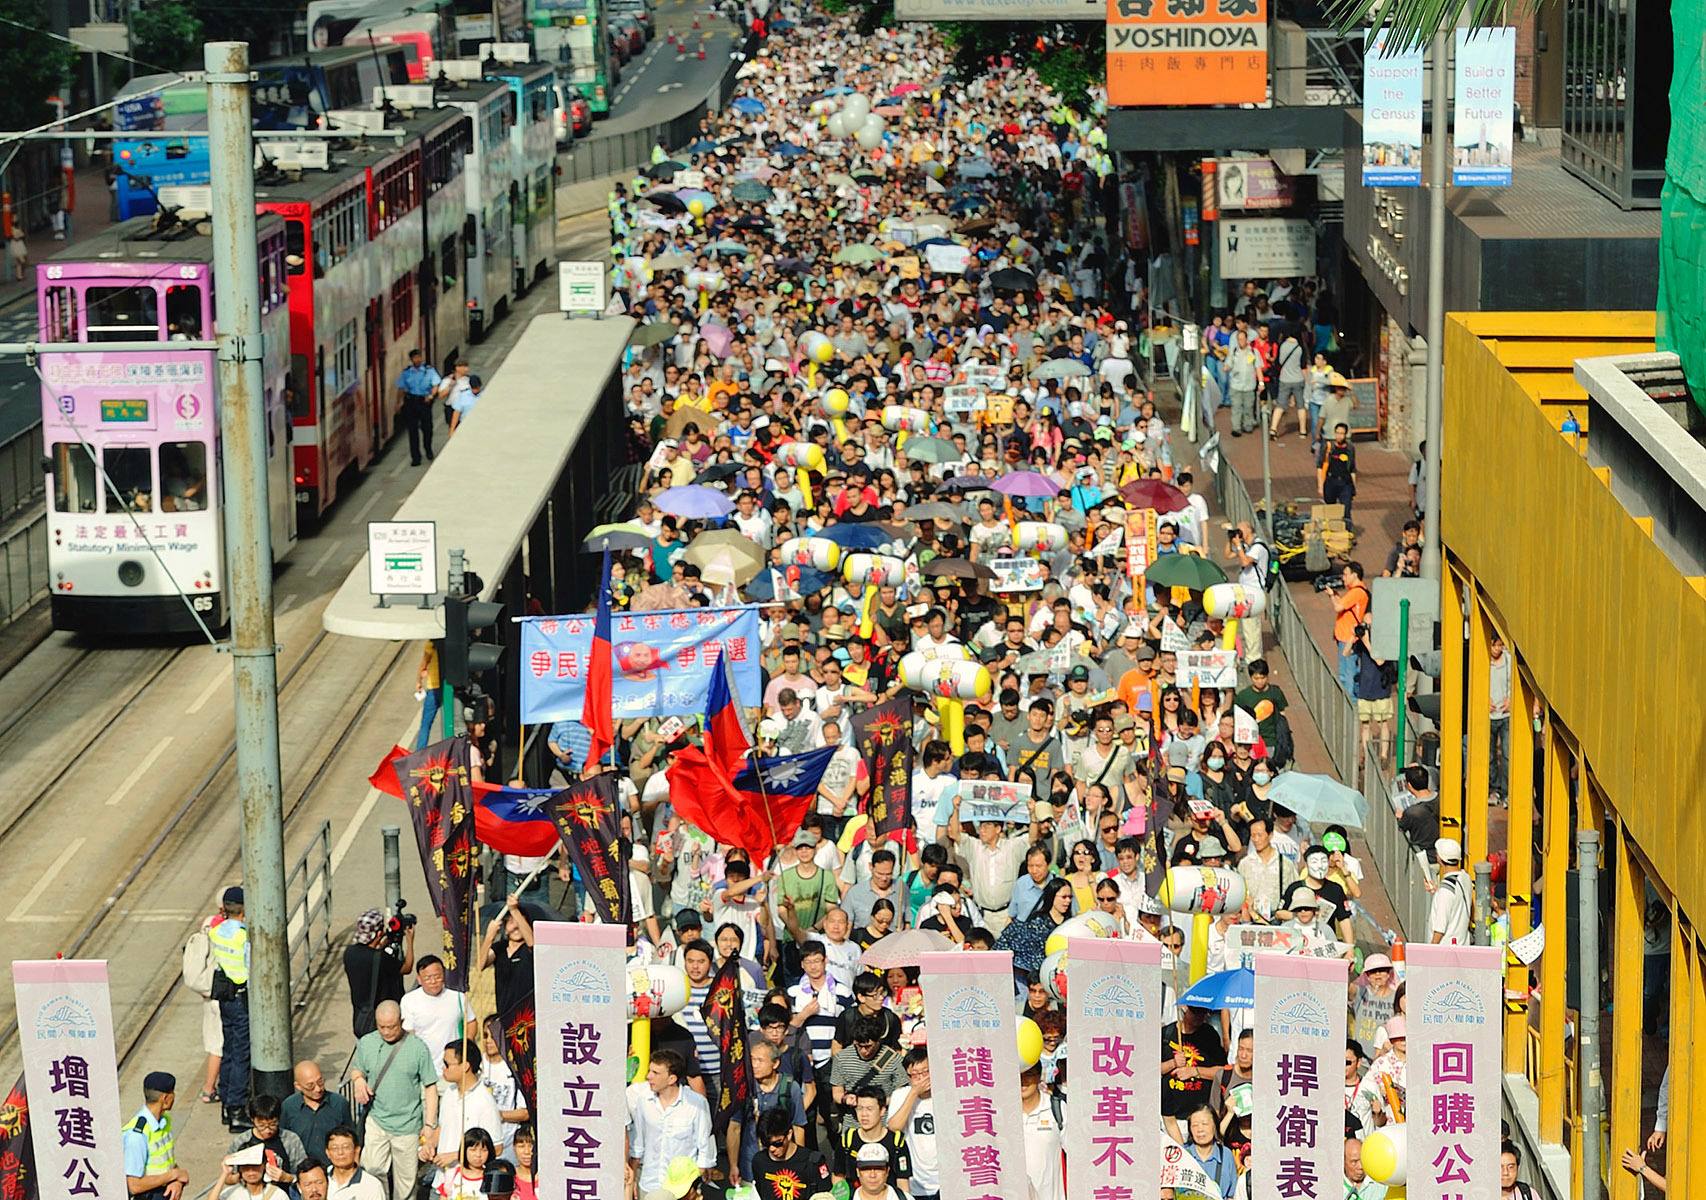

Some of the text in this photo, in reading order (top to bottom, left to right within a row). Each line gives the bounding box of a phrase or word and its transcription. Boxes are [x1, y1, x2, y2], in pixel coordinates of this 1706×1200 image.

[1115, 27, 1258, 48] YOSHINOYA
[1369, 66, 1418, 79] Support
[1464, 66, 1505, 78] Build a
[1383, 89, 1404, 100] the
[1466, 87, 1502, 99] Better
[1371, 108, 1416, 120] Census
[1465, 108, 1503, 120] Future
[46, 266, 63, 279] 65
[180, 265, 197, 279] 65
[68, 543, 113, 554] Statutory
[168, 541, 198, 551] Wage
[193, 596, 213, 611] 65
[1224, 996, 1255, 1006] Suffrag
